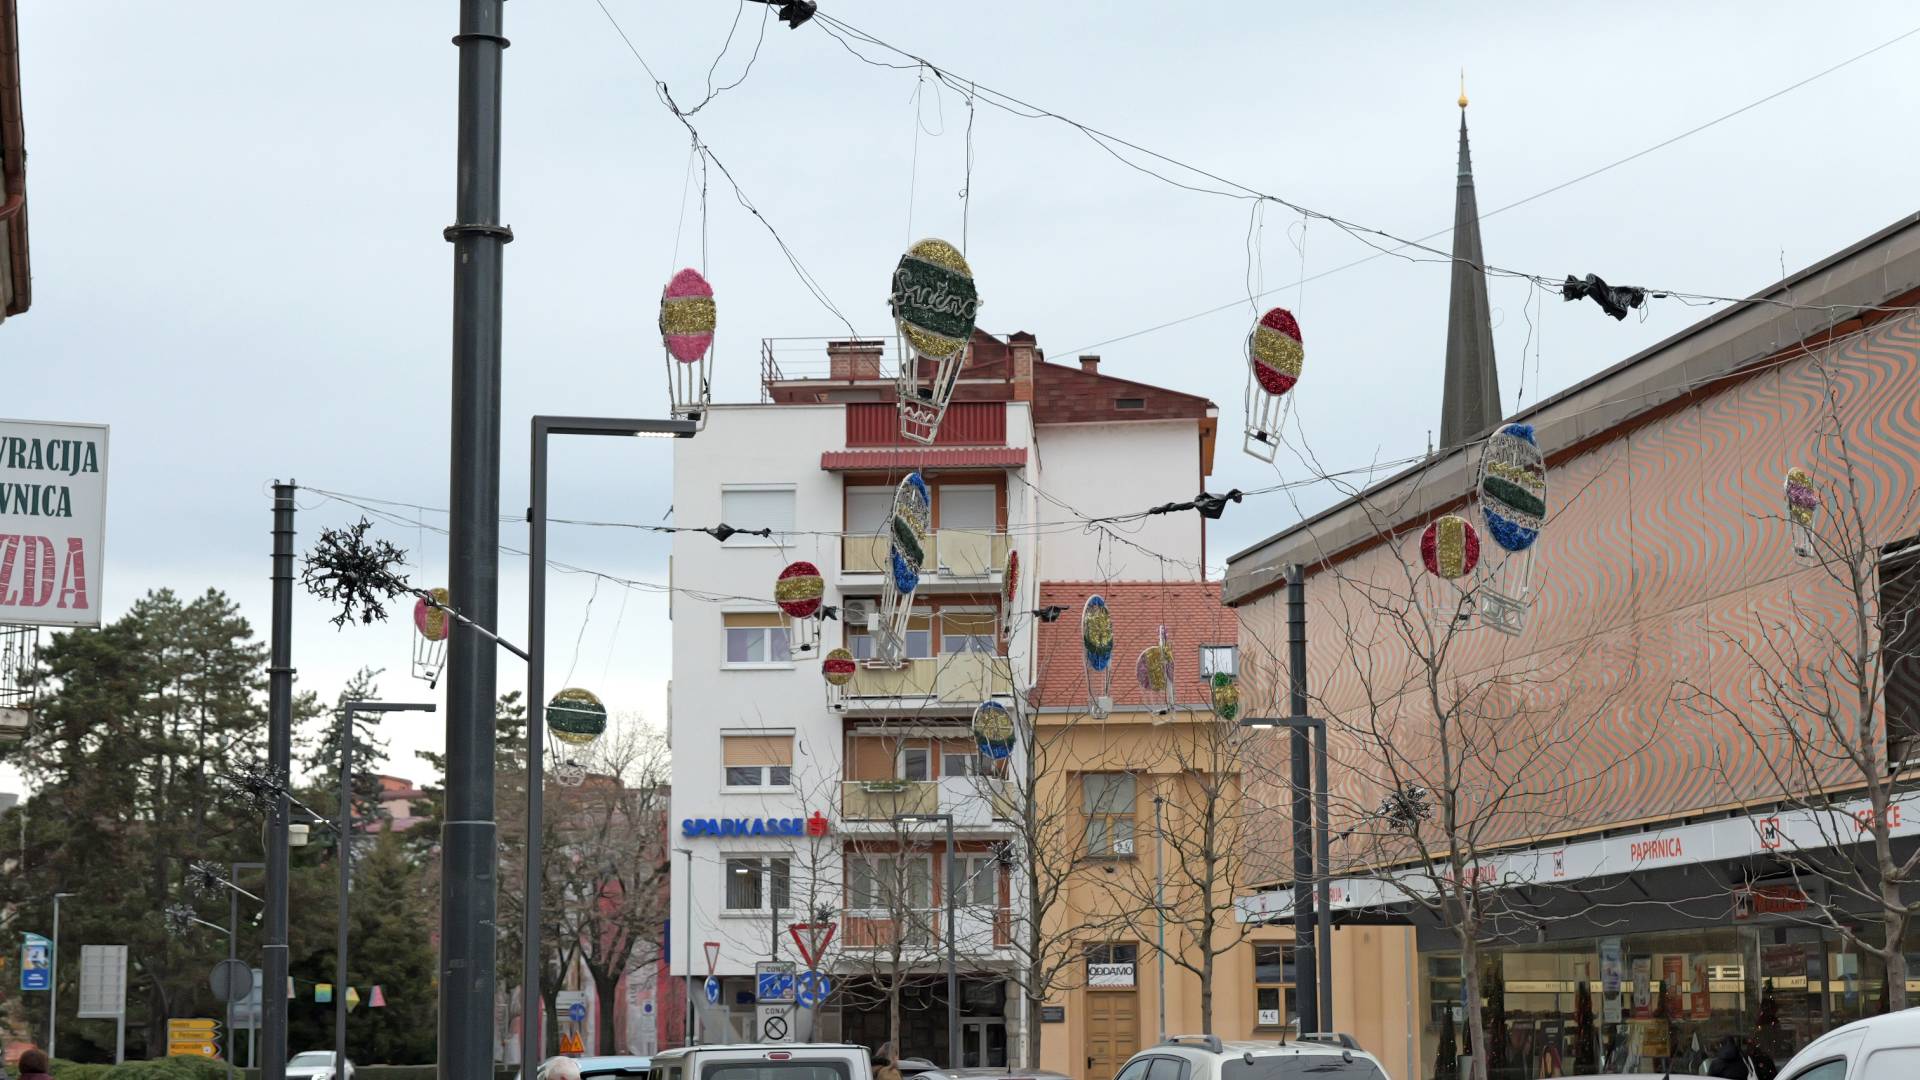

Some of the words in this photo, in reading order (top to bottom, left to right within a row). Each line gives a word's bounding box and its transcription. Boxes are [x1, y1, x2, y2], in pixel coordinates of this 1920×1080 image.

[681, 817, 804, 837] SPARKASSE
[1630, 838, 1682, 861] PAPIRNICA
[765, 1007, 785, 1015] CONA
